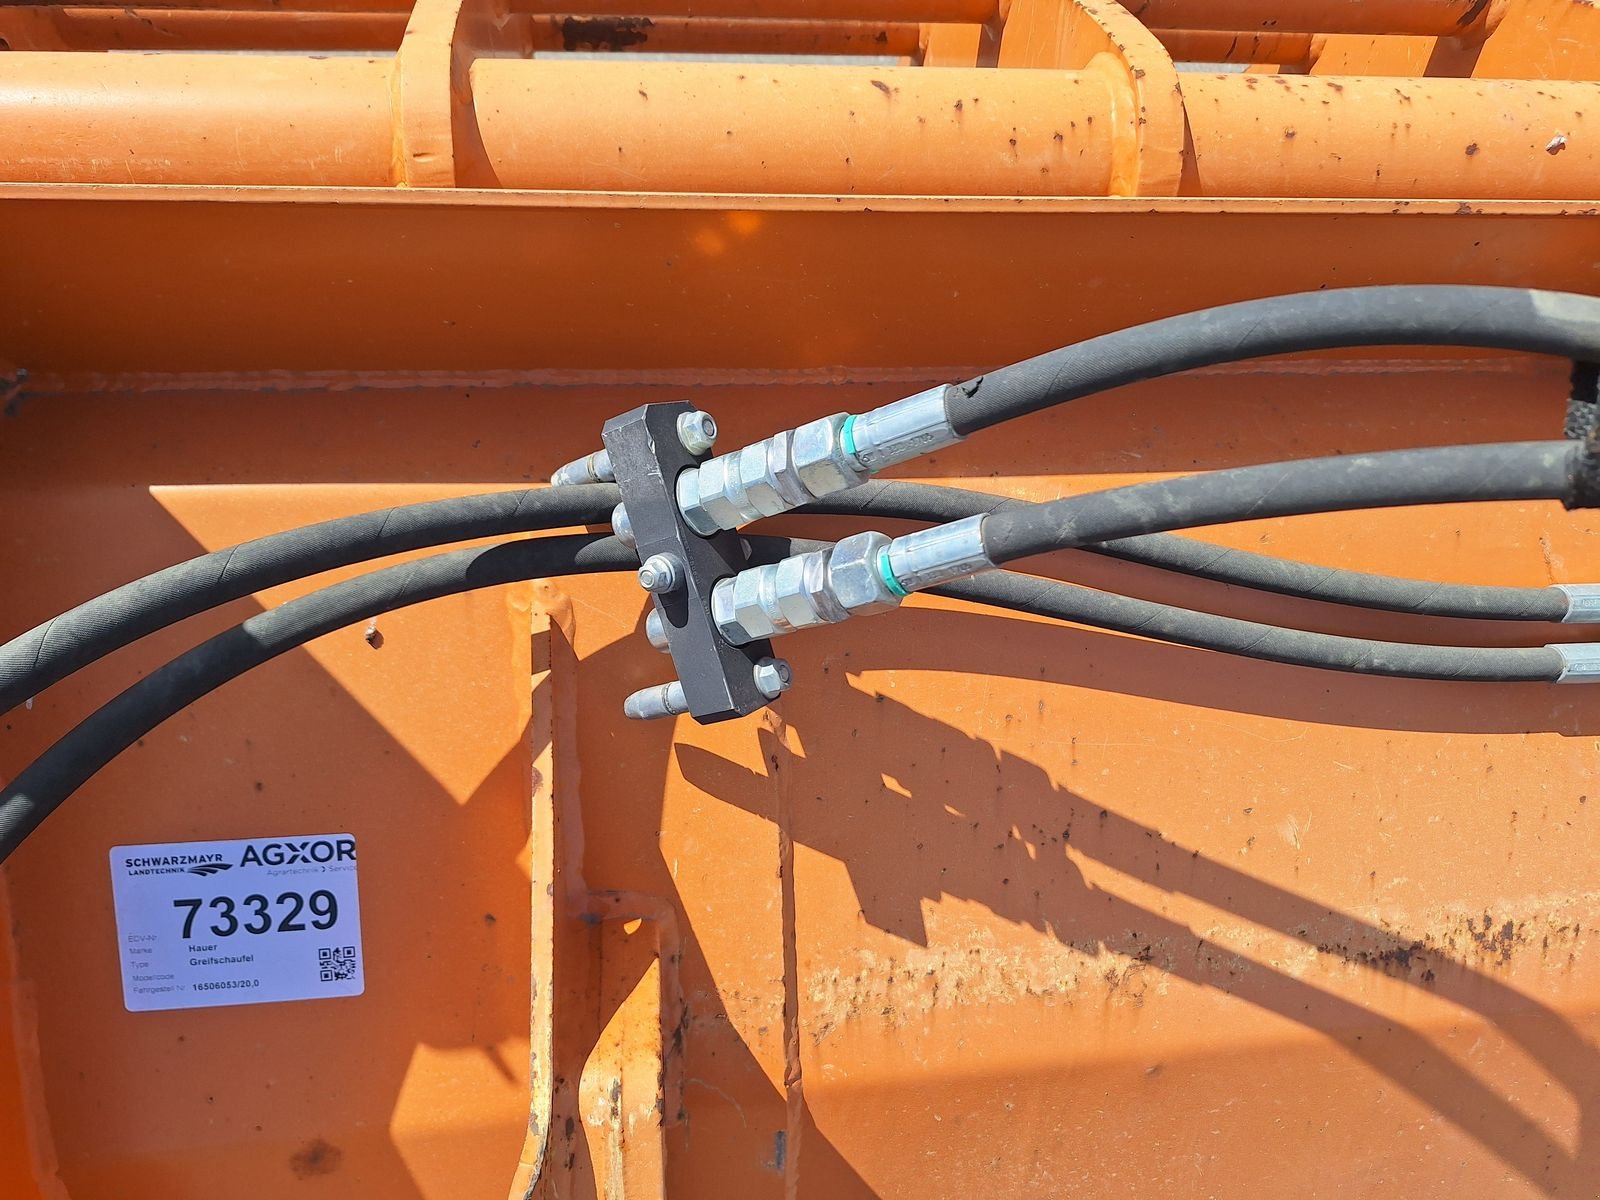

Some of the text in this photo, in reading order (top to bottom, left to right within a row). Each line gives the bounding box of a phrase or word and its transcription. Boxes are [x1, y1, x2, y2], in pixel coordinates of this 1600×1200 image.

[240, 839, 356, 867] AGXOR
[125, 853, 223, 868] SCHWARZMAYR
[128, 868, 185, 876] LANDTECHNIK
[174, 889, 338, 939] 73329
[188, 944, 218, 952] Hauer
[131, 961, 150, 969] Type
[189, 954, 254, 966] Greifschaufel
[192, 979, 260, 991] 16506053/20,0
